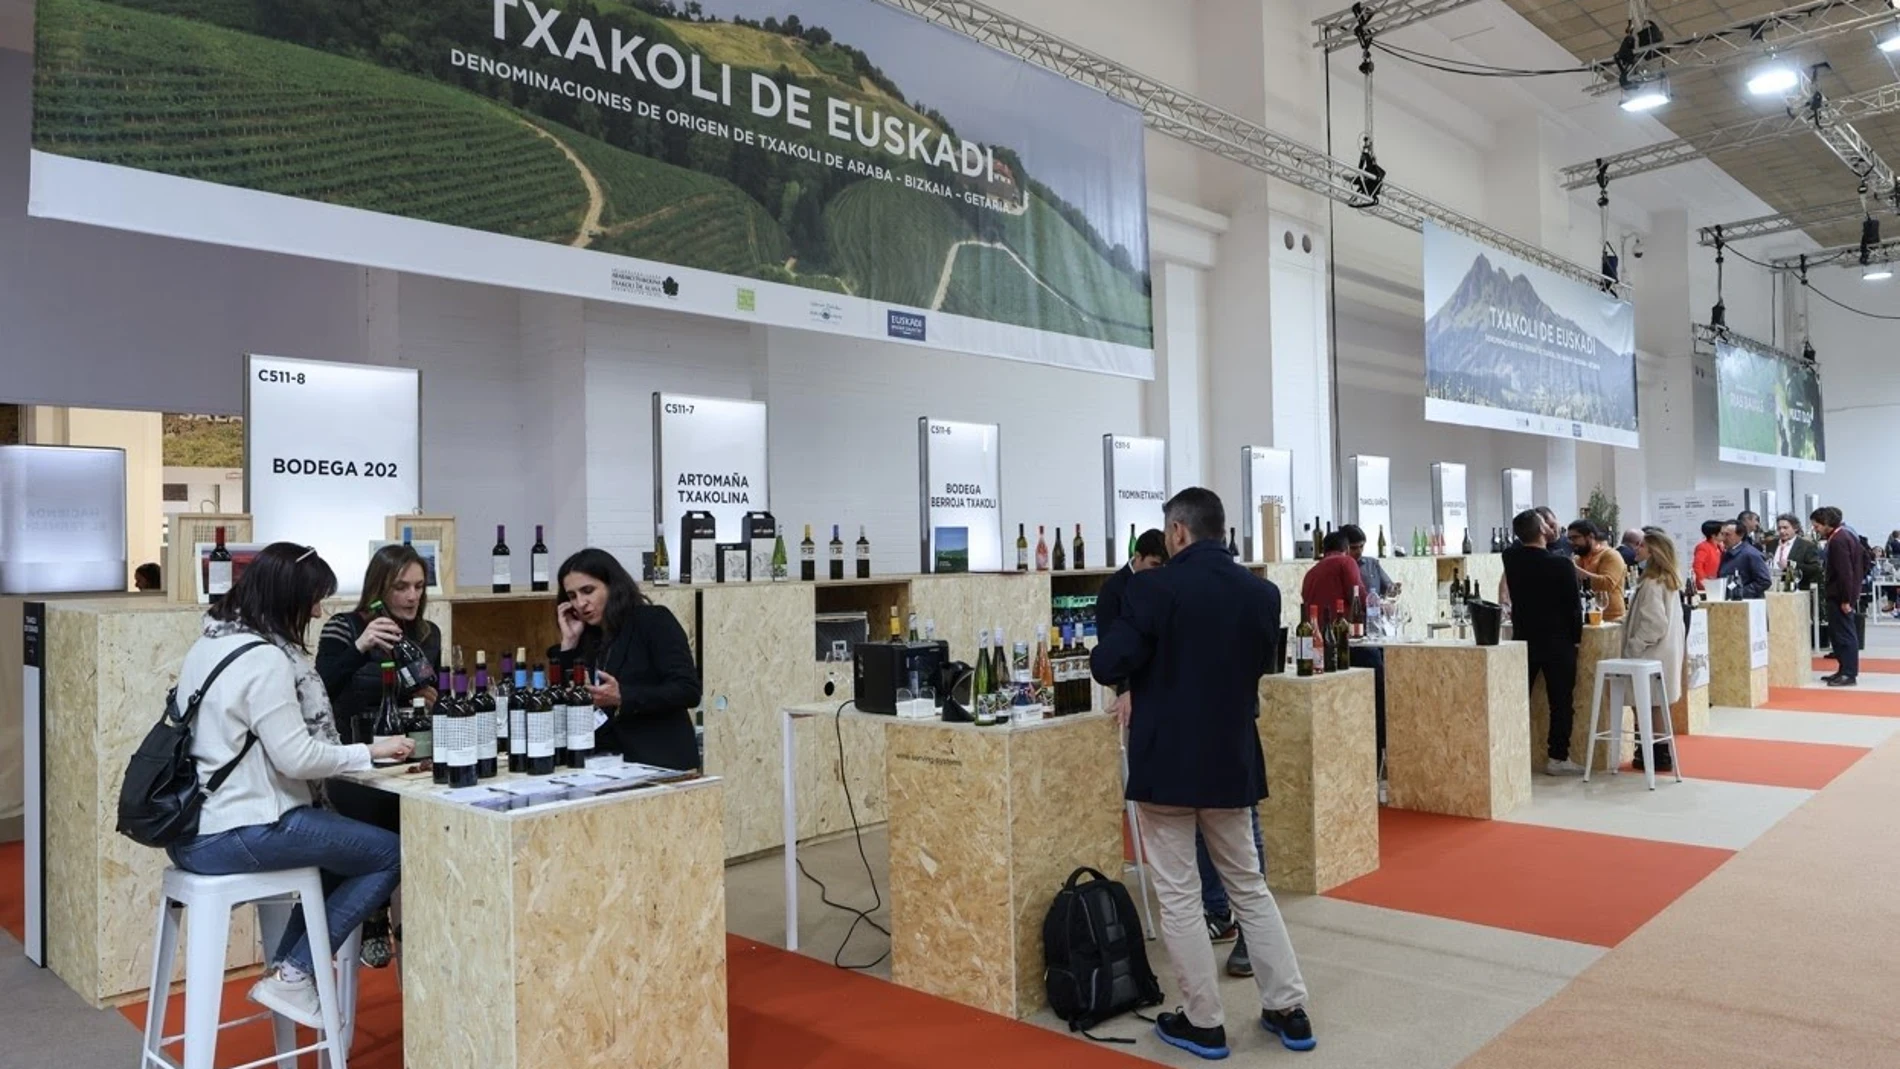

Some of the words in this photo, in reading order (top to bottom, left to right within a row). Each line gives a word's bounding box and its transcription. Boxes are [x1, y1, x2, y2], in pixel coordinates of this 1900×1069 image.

[493, 0, 732, 106] TXAKOLI
[751, 72, 812, 129] DE
[828, 97, 994, 182] EUSKADI
[451, 48, 632, 112] DENOMINACIONES
[637, 100, 661, 120] DE
[666, 109, 729, 139] ORIGEN
[733, 127, 754, 145] DE
[758, 135, 821, 163] TXAKOLI
[825, 151, 844, 169] DE
[847, 159, 893, 182] ARABA
[905, 174, 952, 198] BIZKAIA
[964, 191, 1011, 213] GETARIA
[1489, 306, 1538, 339] TXAKOLI
[1540, 321, 1555, 344] DE
[1556, 326, 1596, 356] EUSKADI
[258, 368, 306, 385] C511-8
[664, 403, 695, 415] C511-7
[272, 458, 358, 477] BODEGA
[364, 462, 398, 479] 202
[677, 472, 749, 488] ARTOMAÑA
[946, 482, 981, 495] BODEGA
[677, 490, 749, 504] TXAKOLINA
[931, 496, 965, 508] BERROJA
[966, 497, 997, 508] TXAKOLI
